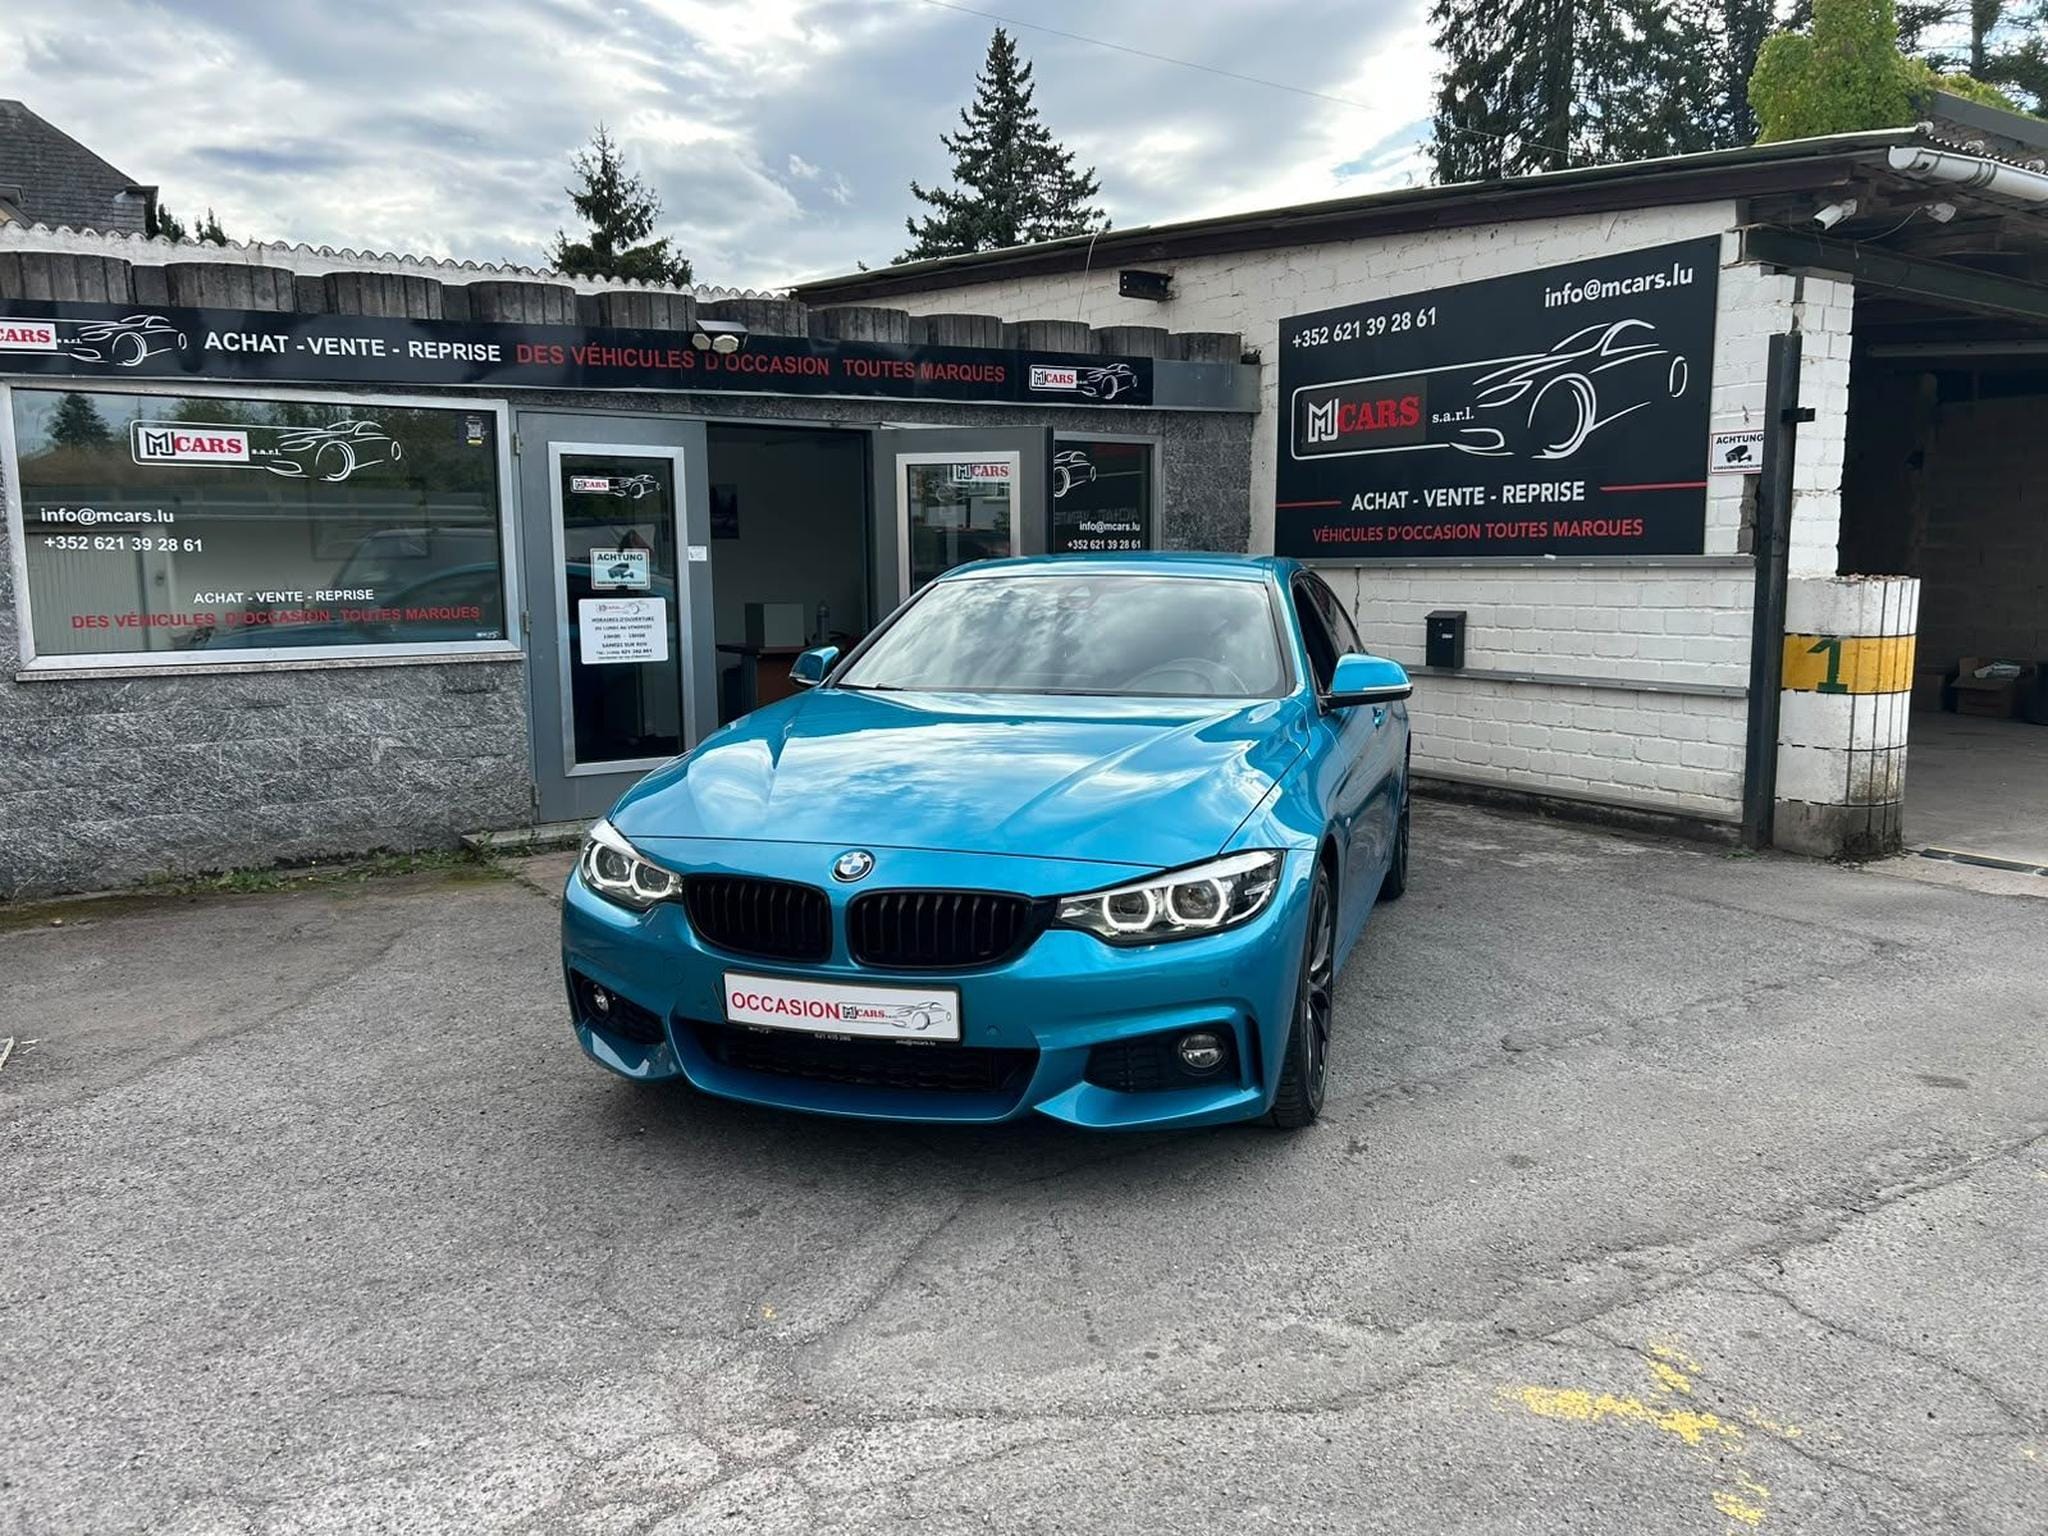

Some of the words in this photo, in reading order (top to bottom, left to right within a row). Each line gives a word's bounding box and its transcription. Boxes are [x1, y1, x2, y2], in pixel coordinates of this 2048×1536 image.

[1544, 263, 1693, 308] info@mcars.lu
[1292, 326, 1329, 348] +352
[1333, 319, 1361, 341] 621
[1366, 315, 1386, 337] 39
[1391, 311, 1412, 333] 28
[1416, 307, 1437, 328] 61
[204, 332, 289, 353] ACHAT
[409, 341, 501, 362] REPRISE
[517, 344, 565, 364] DES
[571, 341, 694, 369] VÉHICULES
[705, 352, 829, 375] DOCCASION
[843, 359, 915, 378] TOUTES
[921, 362, 1005, 383] MARQUES
[1432, 407, 1475, 423] s.a.r.l.
[1716, 433, 1764, 444] ACHTUNG
[1351, 491, 1408, 511] ACHAT
[1424, 487, 1485, 507] VENTE
[1502, 480, 1585, 503] REPRISE
[40, 508, 174, 526] info@mcars.lu
[1079, 521, 1140, 533] info@mcars.lu
[1312, 524, 1383, 543] VÉHICULES
[1387, 523, 1480, 542] D'OCCASION
[1485, 521, 1548, 539] TOUTES
[1553, 518, 1643, 538] MARQUES
[44, 536, 88, 550] +352
[94, 537, 125, 550] 621
[132, 538, 152, 551] 39
[158, 538, 178, 551] 28
[183, 538, 202, 552] 61
[1067, 540, 1088, 549] +352
[1090, 540, 1105, 549] 621
[1107, 540, 1117, 549] 39
[1120, 540, 1130, 549] 28
[1131, 540, 1141, 549] 61
[597, 553, 643, 561] ACHTUNG
[193, 592, 244, 604] ACHAT
[256, 591, 303, 603] VENTE
[316, 590, 374, 601] REPRISE
[72, 615, 109, 628] DES
[114, 611, 216, 628] VÉHICULES
[340, 608, 400, 623] TOUTES
[406, 606, 480, 620] MARQUES
[1807, 638, 1848, 693] 1
[732, 992, 840, 1020] OCCASION
